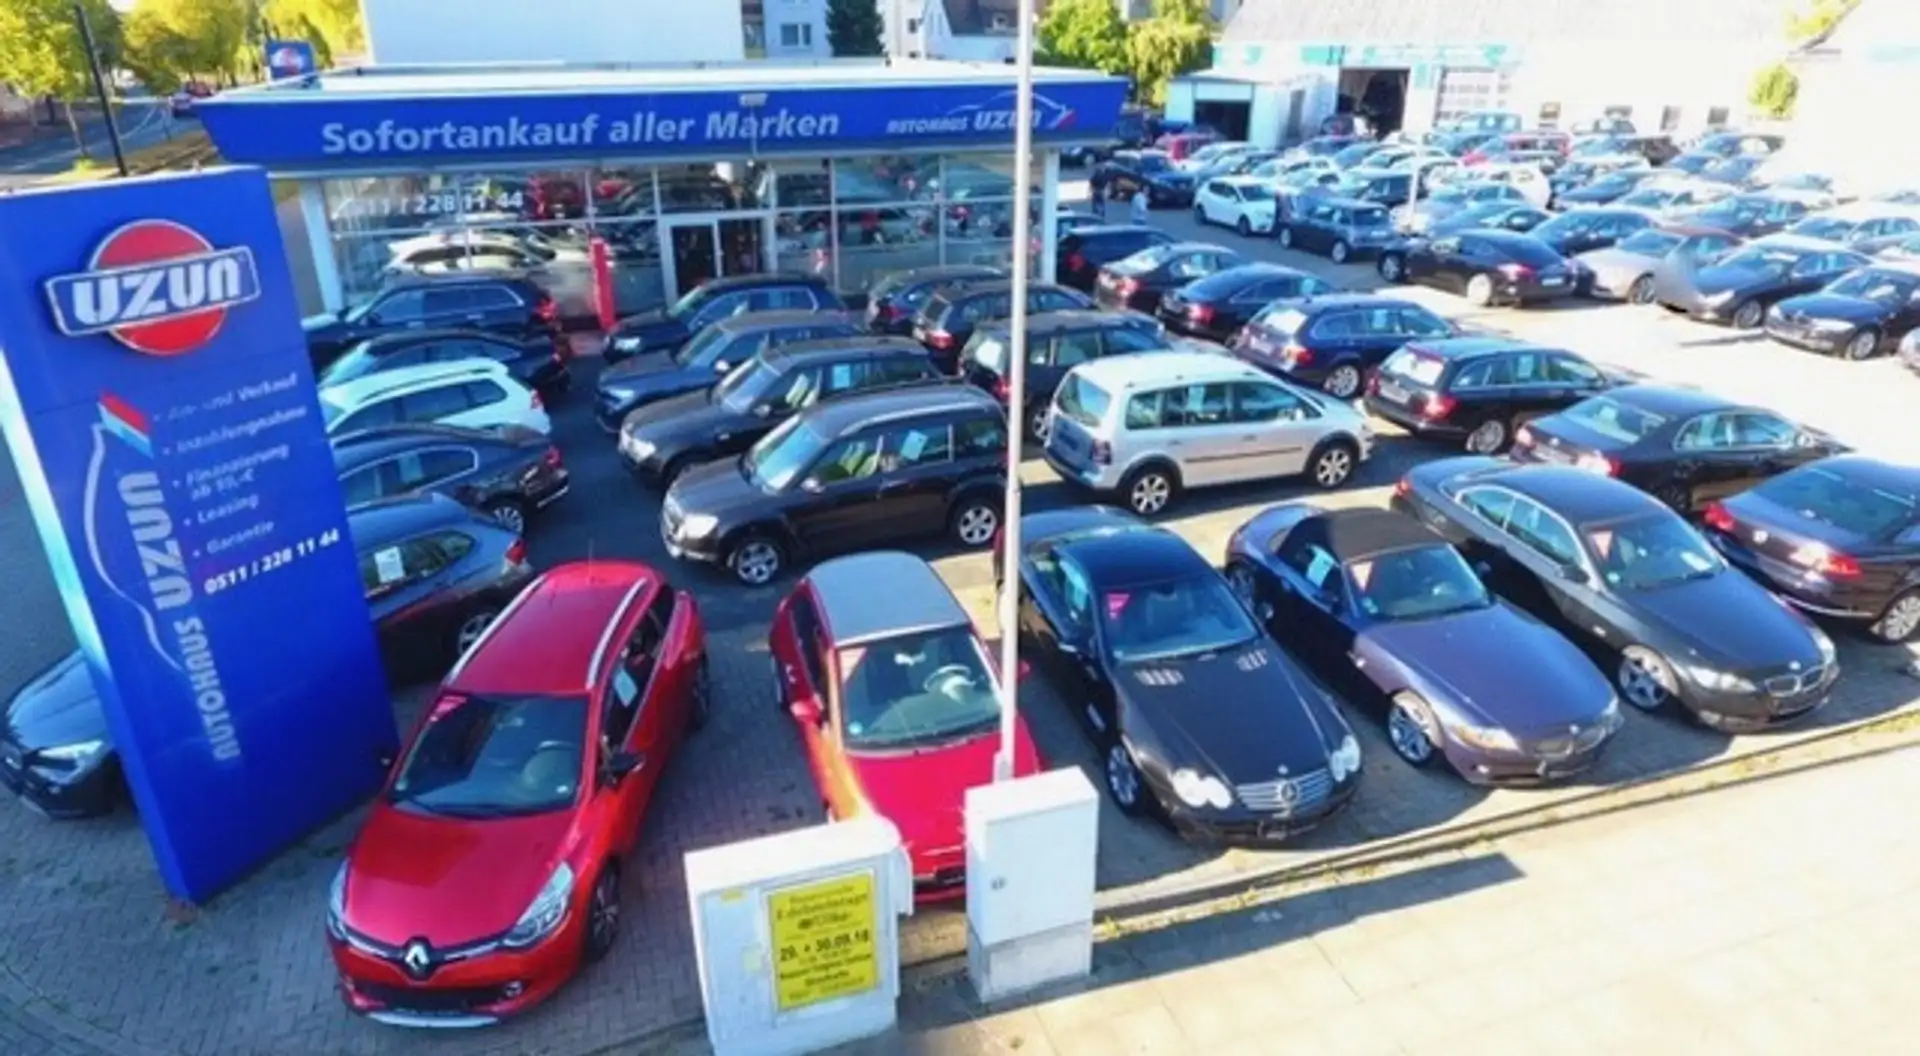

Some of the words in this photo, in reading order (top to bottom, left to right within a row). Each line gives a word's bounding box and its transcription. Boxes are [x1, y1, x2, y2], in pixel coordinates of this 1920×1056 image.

[322, 113, 600, 154] Sofortankauf
[609, 111, 696, 143] aller
[705, 108, 840, 140] Marken
[237, 372, 298, 401] Verkauf
[197, 494, 260, 524] Leasing
[206, 521, 275, 554] Garantie
[204, 565, 248, 595] 0511
[261, 547, 294, 573] 228
[296, 537, 317, 557] 11
[318, 527, 341, 548] 44
[173, 616, 242, 761] AUTOHAUS
